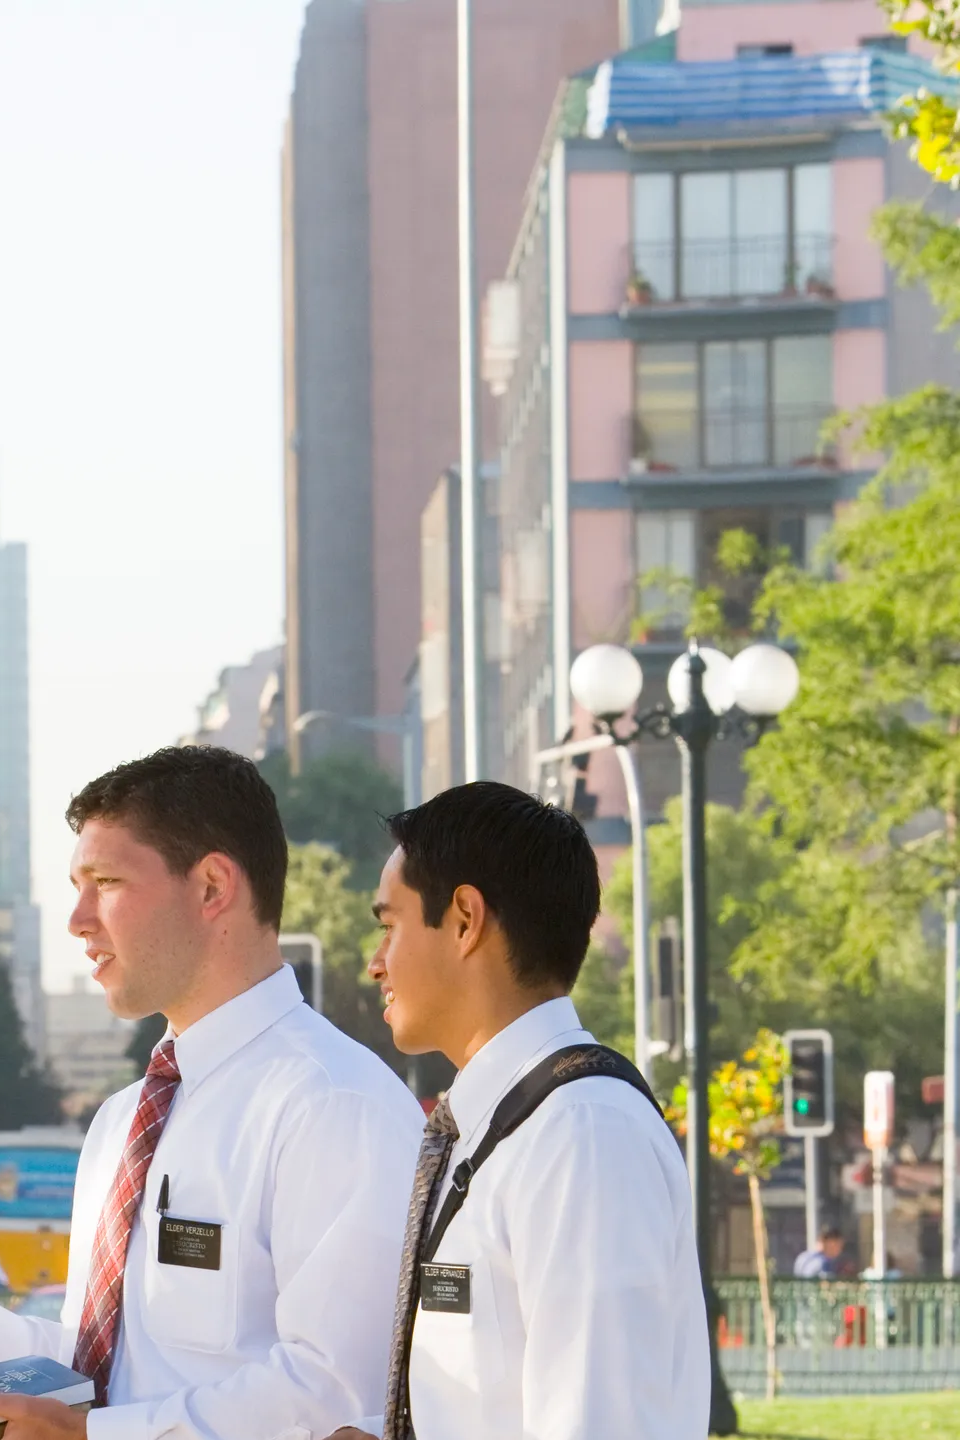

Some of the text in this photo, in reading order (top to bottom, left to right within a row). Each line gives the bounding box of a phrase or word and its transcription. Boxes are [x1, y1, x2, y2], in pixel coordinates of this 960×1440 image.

[166, 1223, 184, 1233] ELDER
[425, 1267, 439, 1277] ELDER
[22, 1369, 37, 1377] EL
